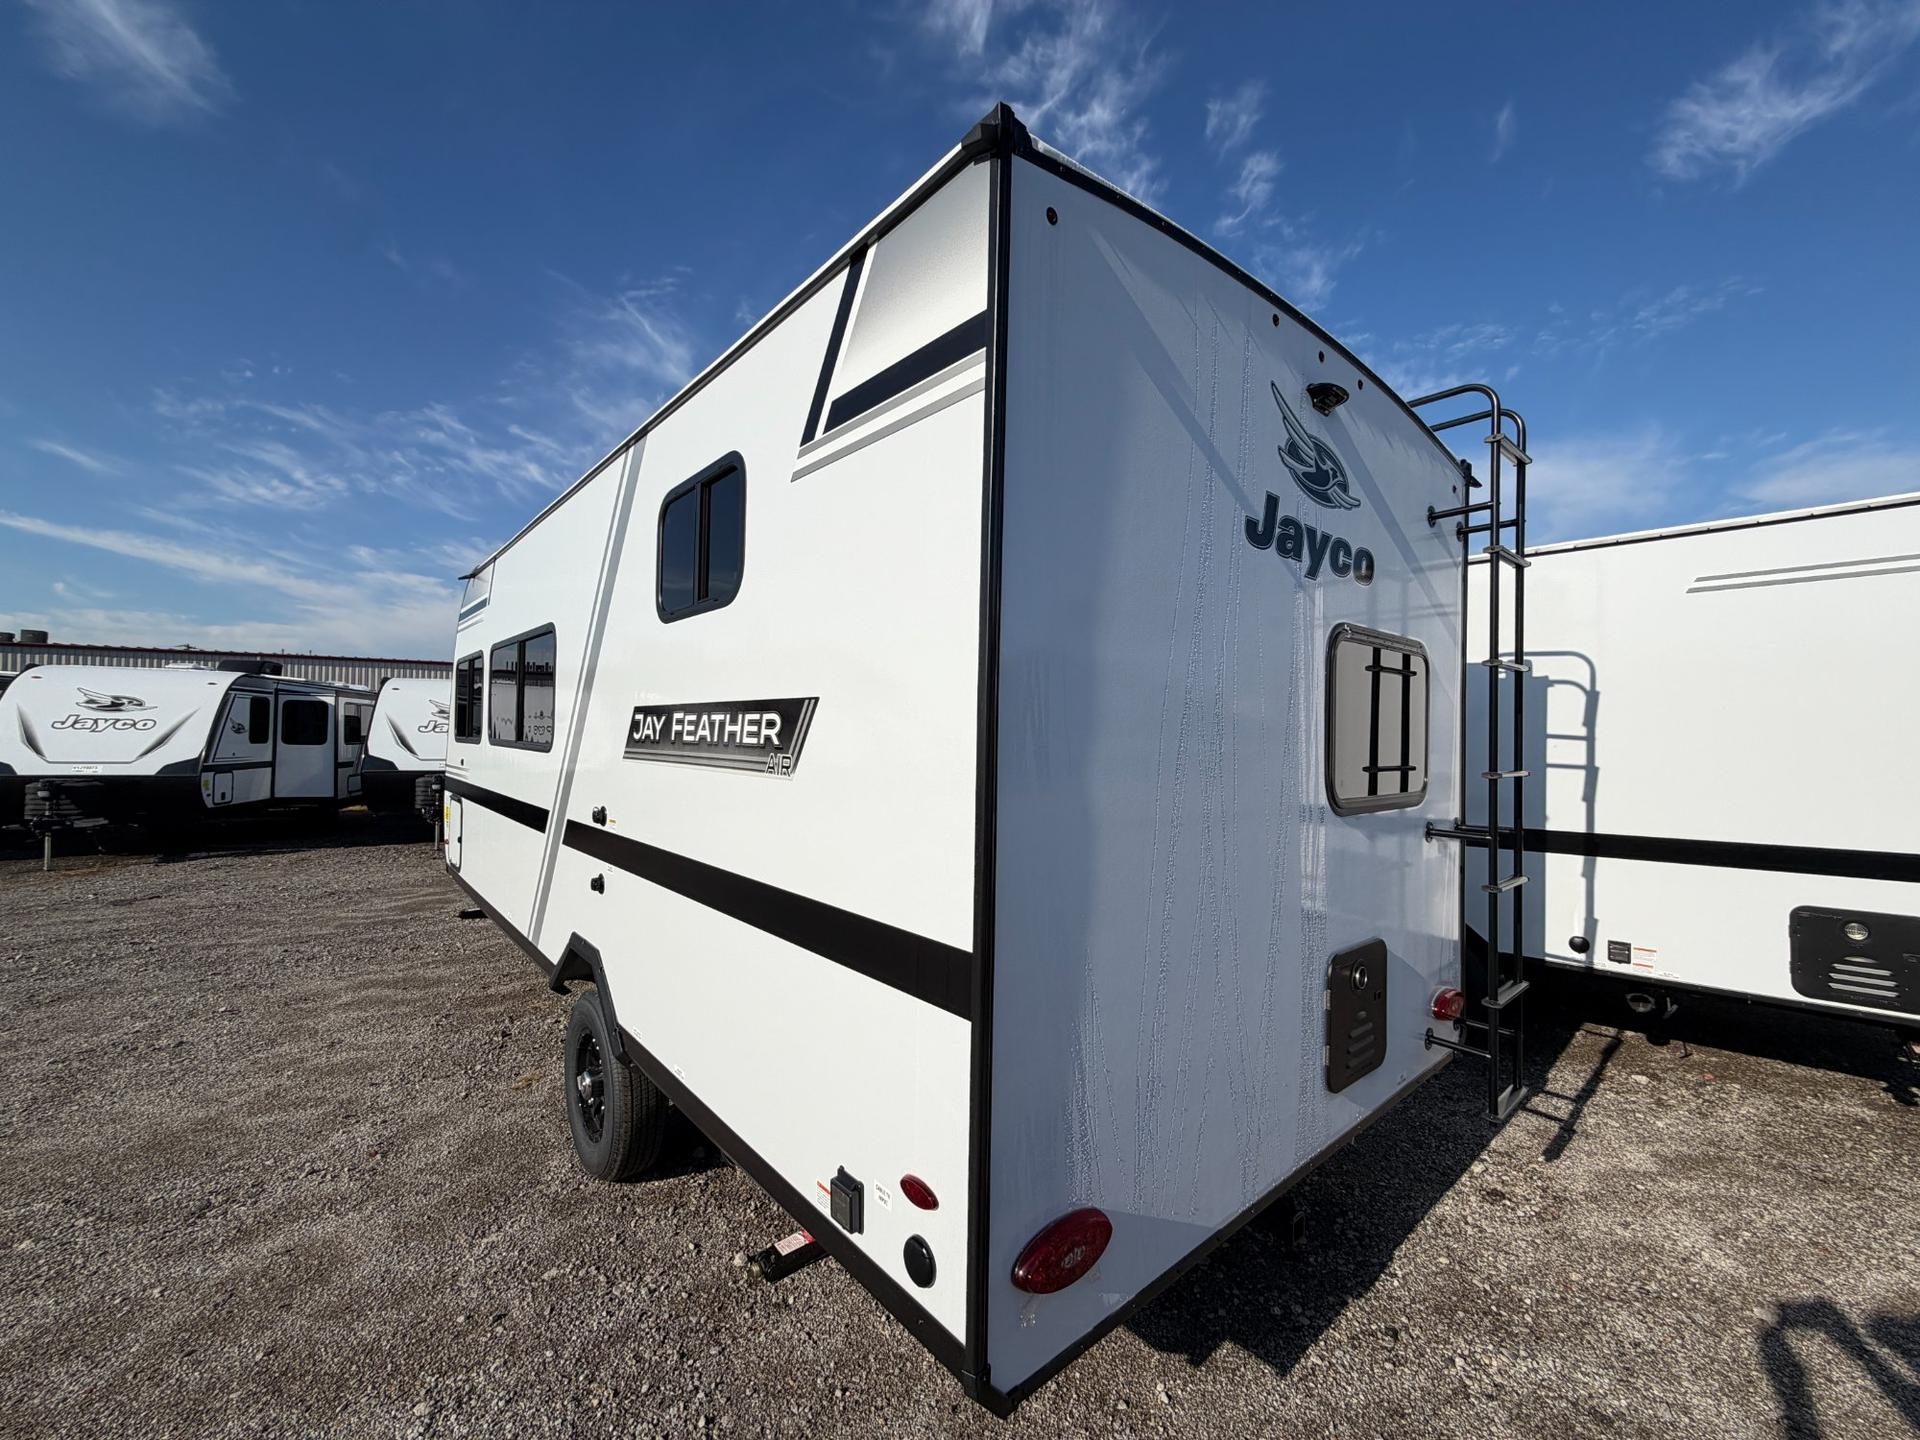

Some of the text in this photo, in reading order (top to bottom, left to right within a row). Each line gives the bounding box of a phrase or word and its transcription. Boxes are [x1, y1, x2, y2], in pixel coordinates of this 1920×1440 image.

[1244, 490, 1375, 586] Jayco
[51, 714, 157, 733] Jayco
[633, 711, 783, 747] JAY FEATHER
[765, 753, 792, 776] AIR
